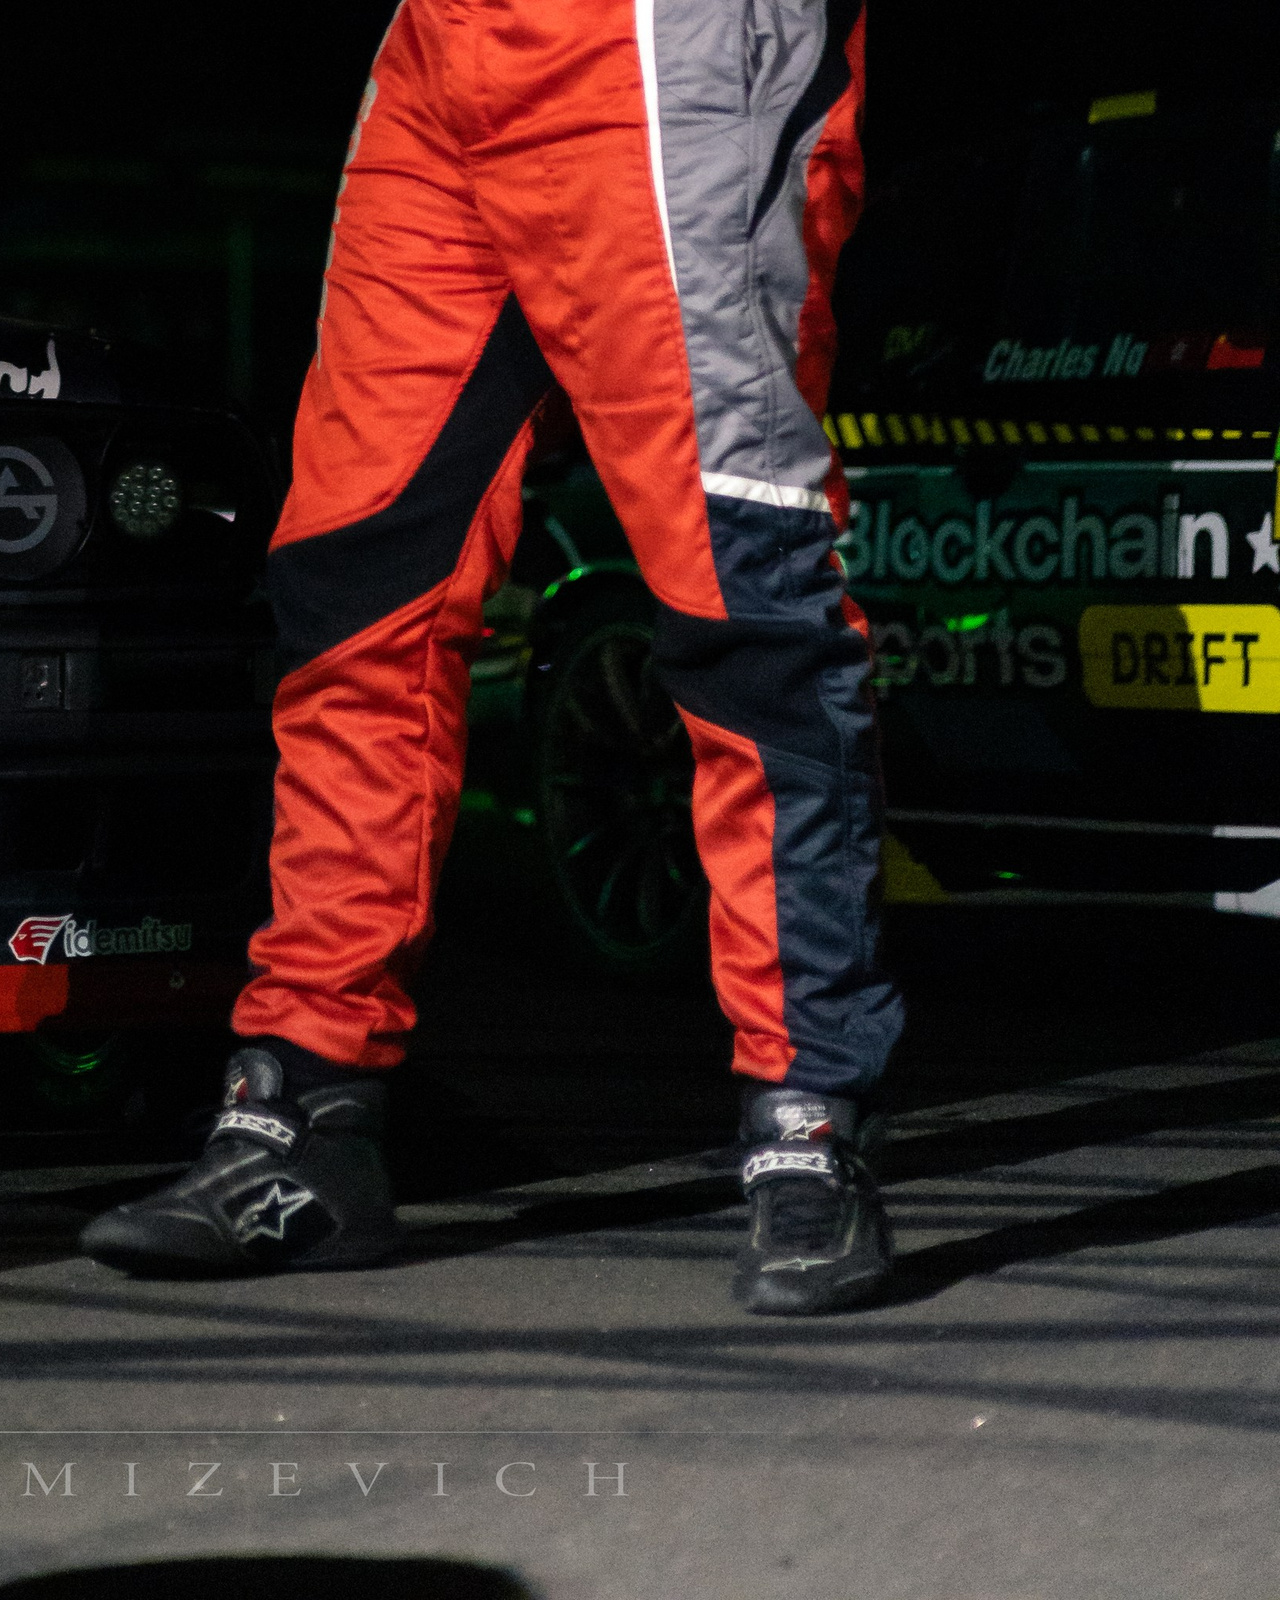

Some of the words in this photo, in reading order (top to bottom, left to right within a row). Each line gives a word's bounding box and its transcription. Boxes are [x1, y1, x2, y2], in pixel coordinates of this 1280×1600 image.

[983, 336, 1101, 384] Charles
[836, 493, 1230, 581] Blockchain
[873, 607, 1068, 700] ports
[1111, 632, 1259, 687] DRIFT
[63, 916, 193, 958] idemitsu
